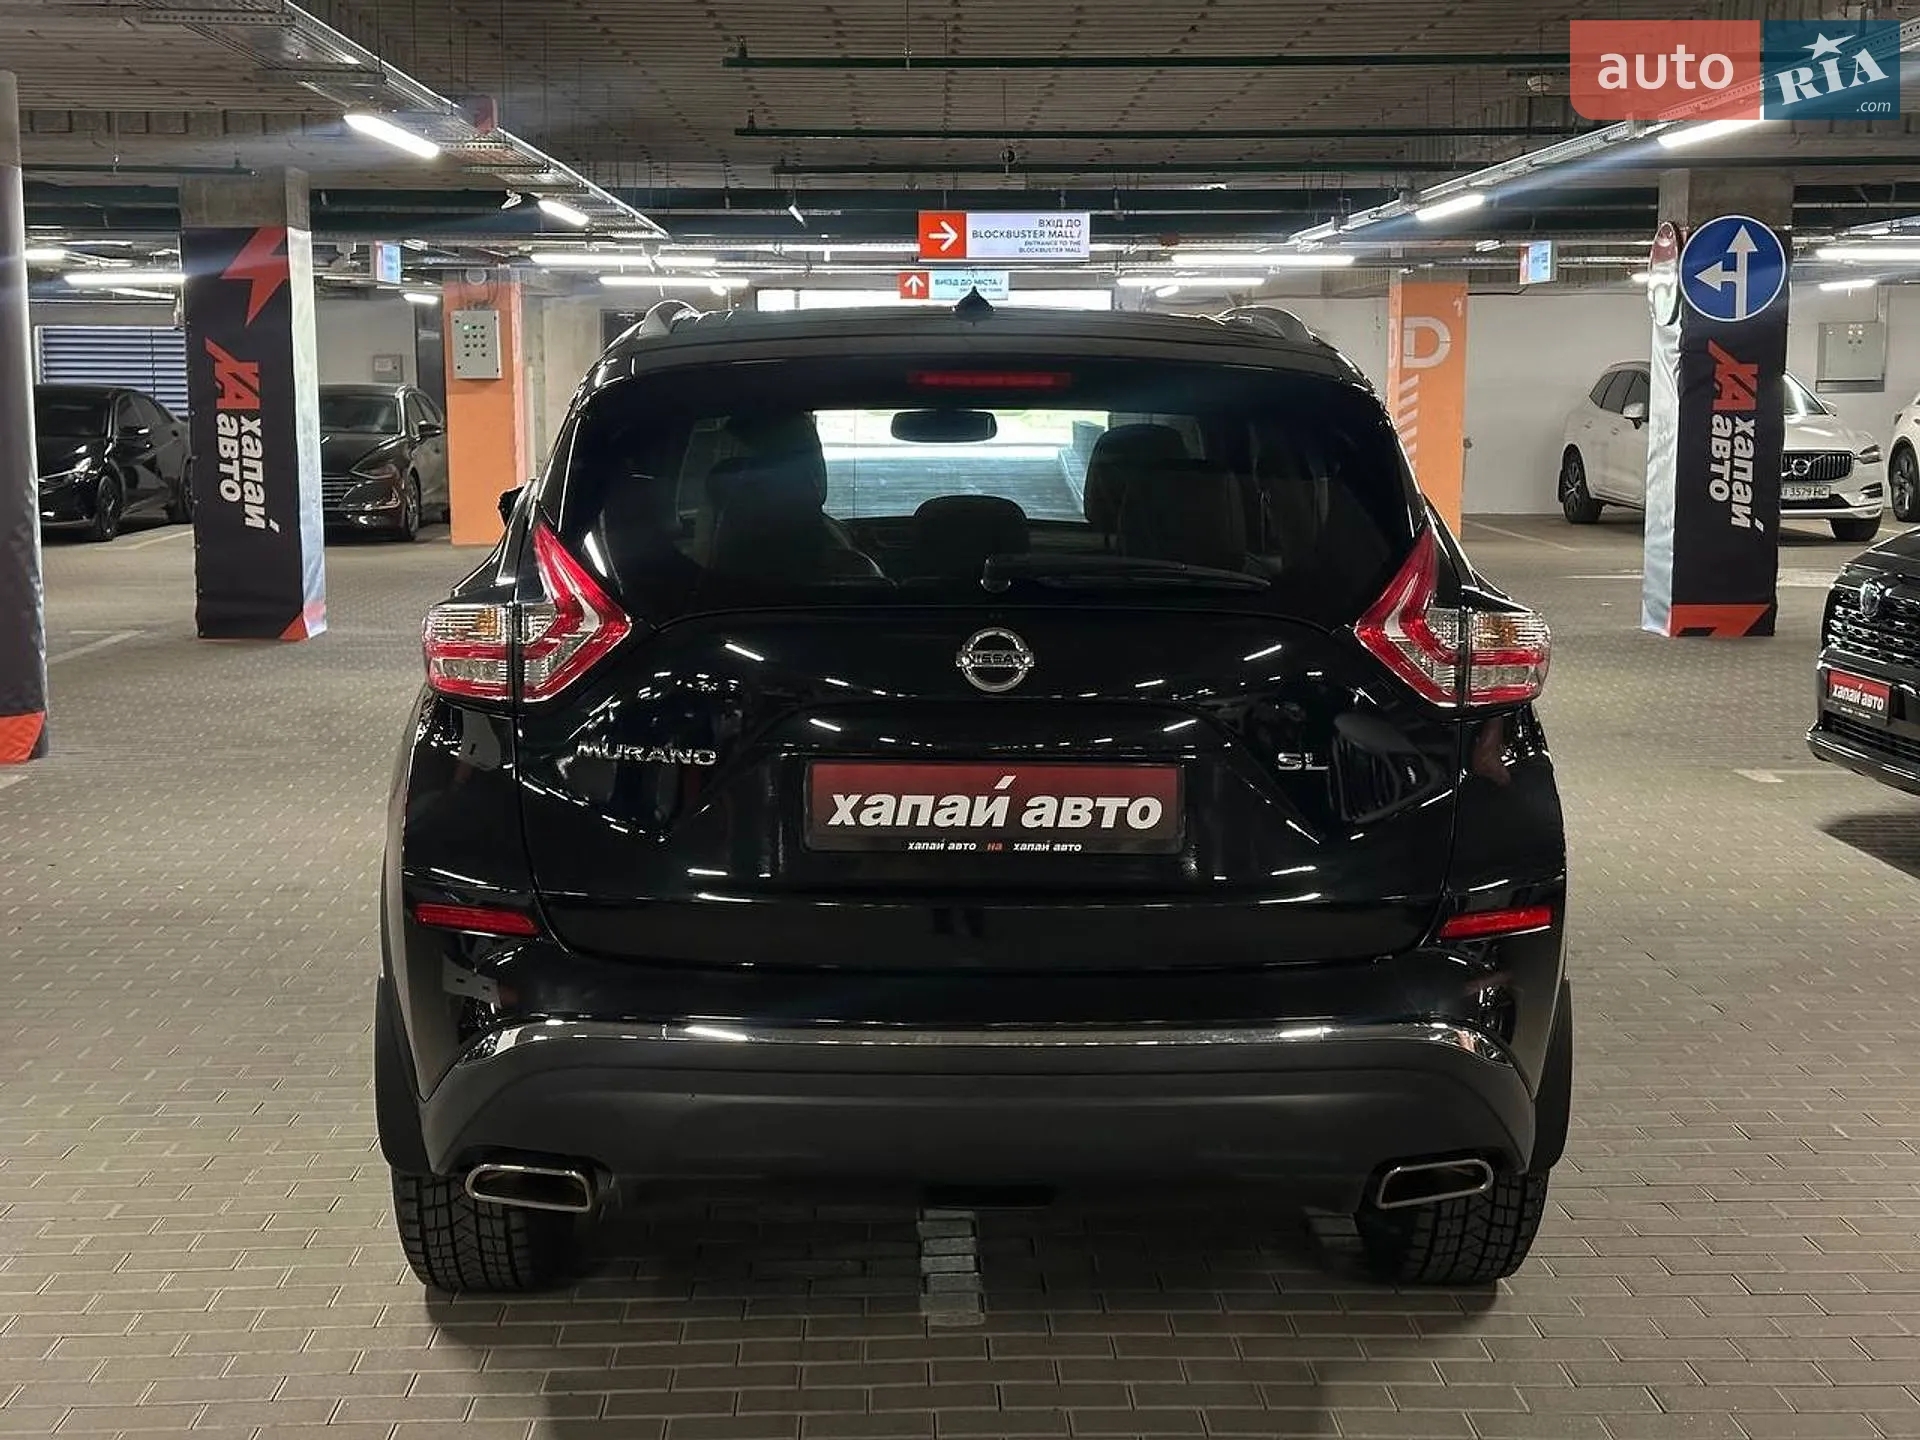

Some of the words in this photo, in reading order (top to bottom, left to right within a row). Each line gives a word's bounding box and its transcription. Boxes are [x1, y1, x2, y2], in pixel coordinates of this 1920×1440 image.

[972, 229, 1046, 239] BLOCKBUSTER
[1047, 229, 1074, 239] MALL
[1038, 219, 1063, 228] ВХІД
[1066, 219, 1081, 228] ДО
[1403, 316, 1452, 369] D
[216, 412, 242, 502] авто
[1708, 413, 1733, 502] авто
[239, 415, 280, 533] хапай
[1730, 416, 1765, 532] хапай
[1789, 487, 1812, 496] 3579
[961, 652, 1030, 665] NISSAN
[1861, 692, 1884, 711] авто
[576, 741, 718, 767] MURANO
[1278, 752, 1329, 770] SL
[827, 775, 1017, 828] хапай
[1020, 794, 1164, 831] авто
[907, 838, 946, 851] хапай
[947, 841, 977, 851] авто
[986, 841, 1003, 851] на
[1012, 839, 1050, 852] хапай
[1052, 842, 1082, 852] авто
